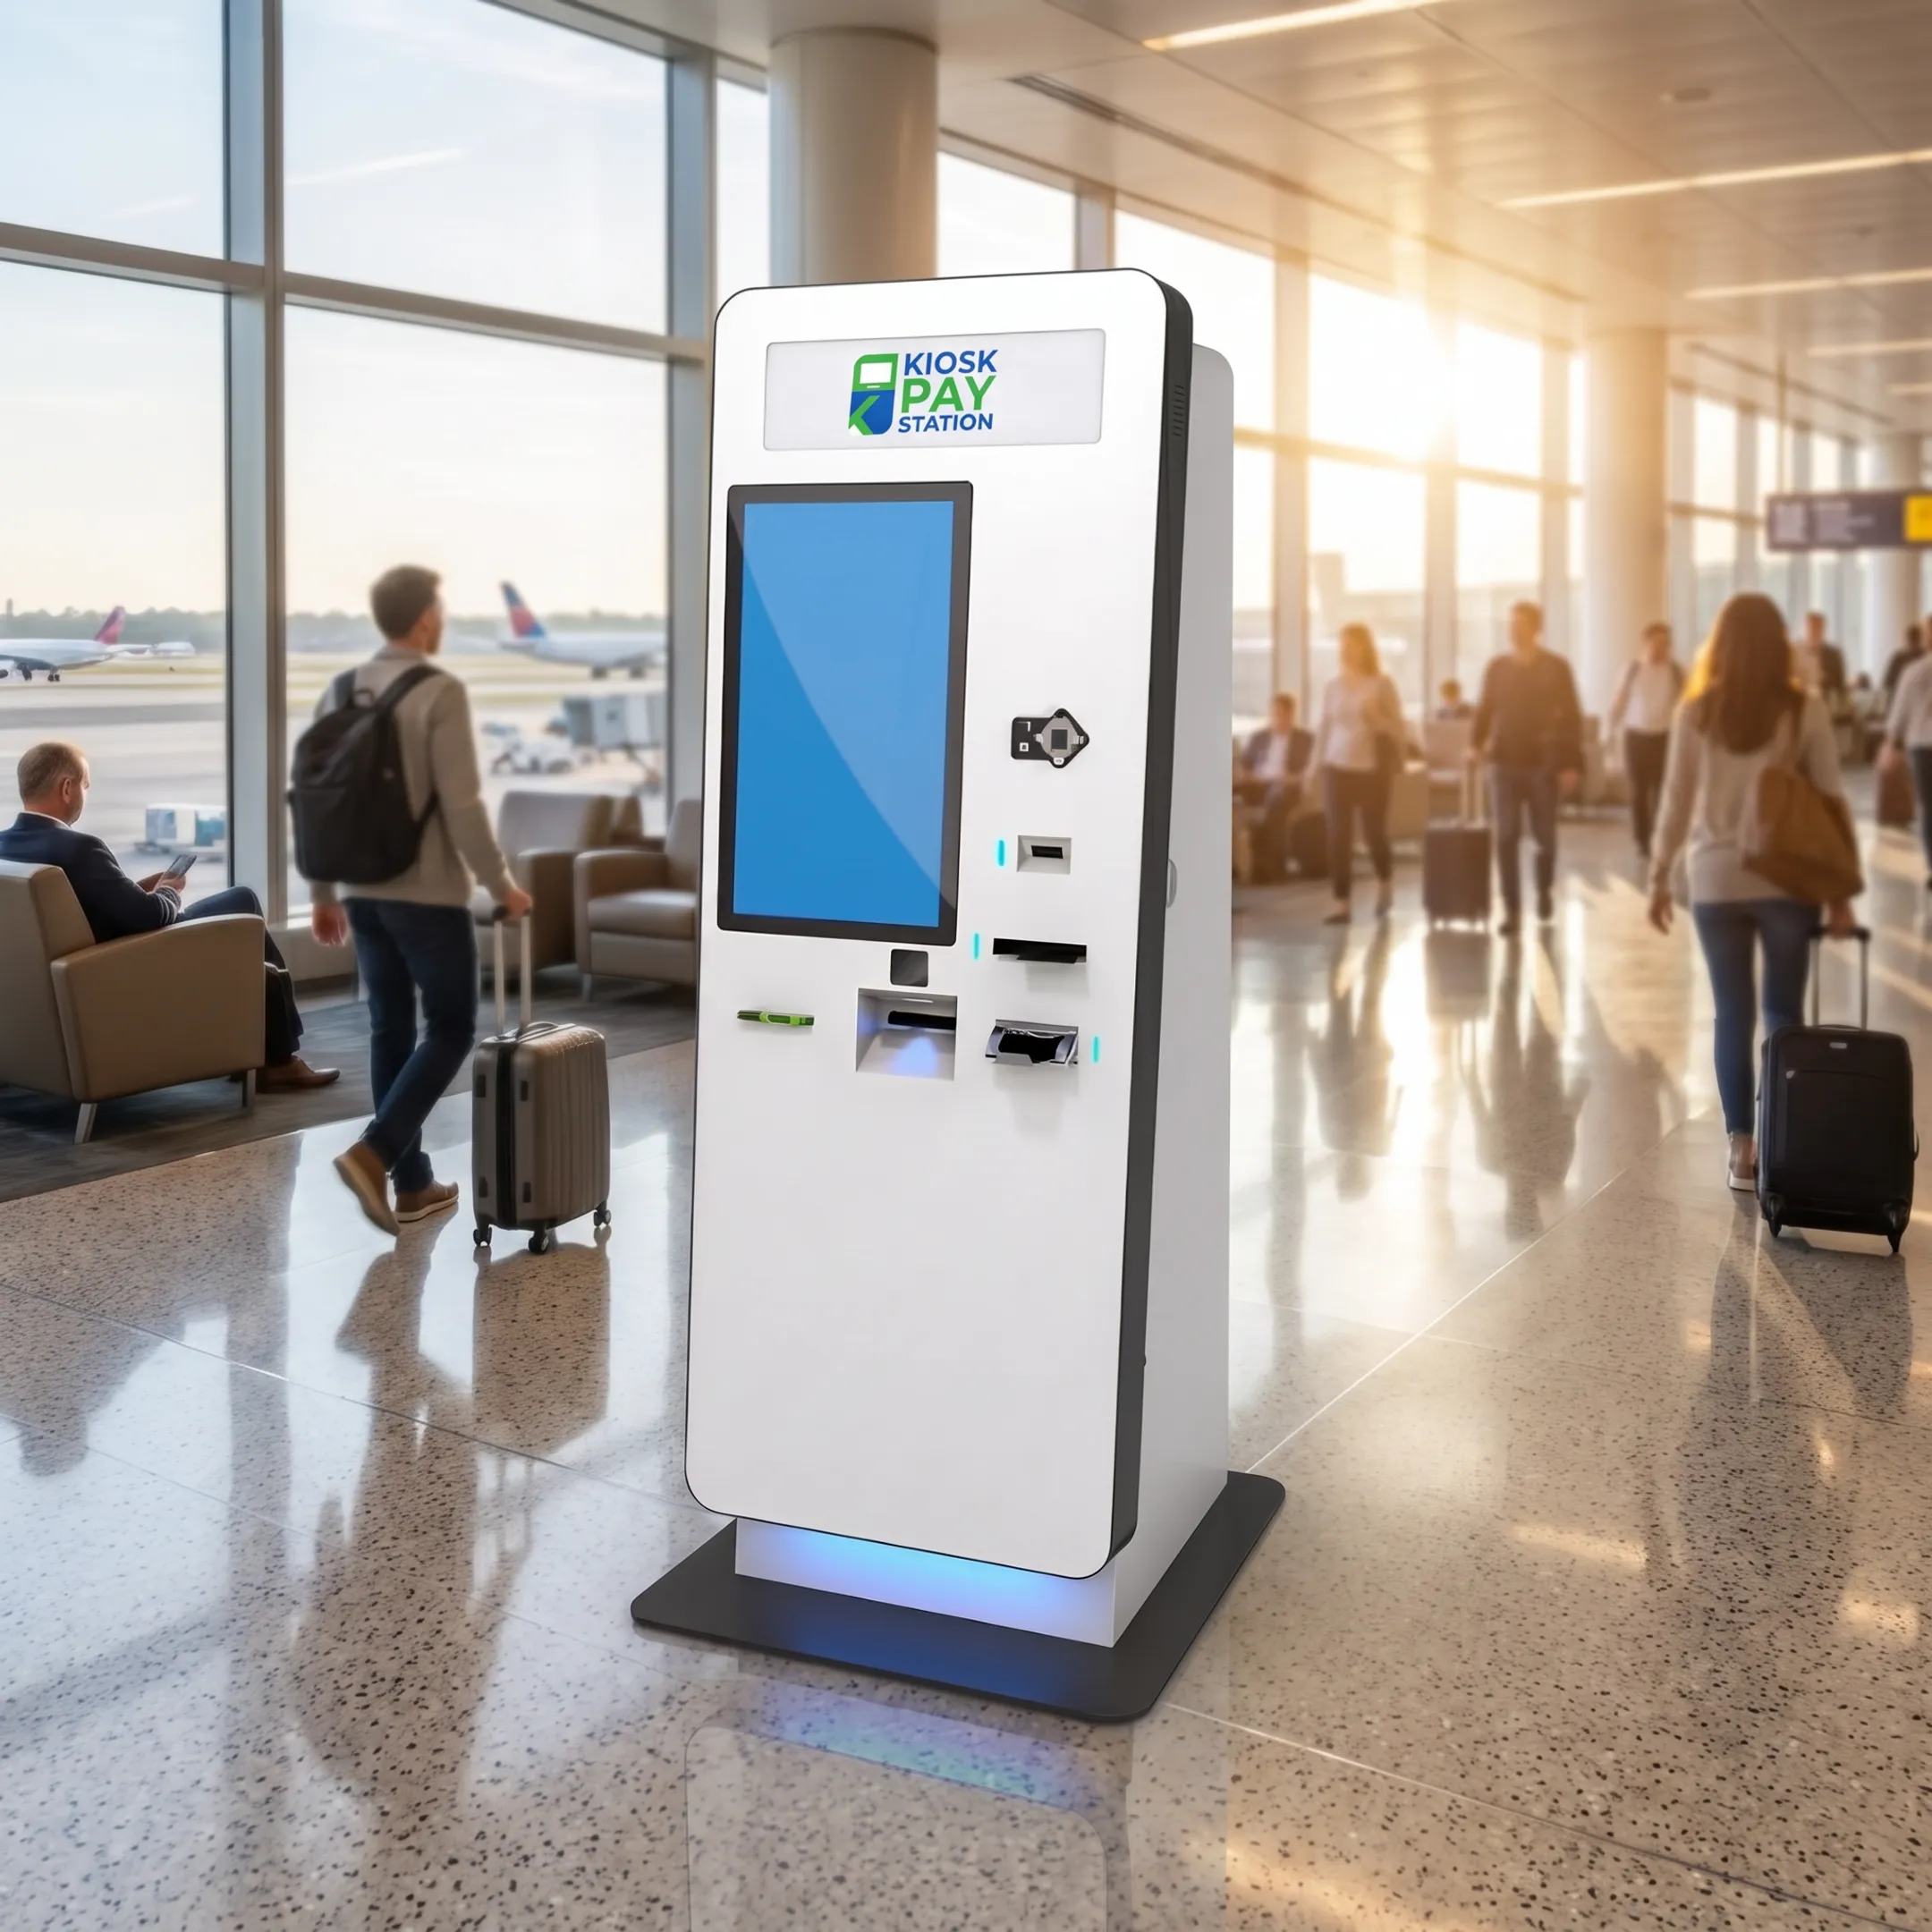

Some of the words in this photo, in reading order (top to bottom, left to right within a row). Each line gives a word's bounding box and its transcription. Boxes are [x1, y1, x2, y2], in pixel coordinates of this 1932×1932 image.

[904, 350, 998, 375] KIOSK
[901, 377, 996, 412] PAY
[898, 414, 993, 433] STATION
